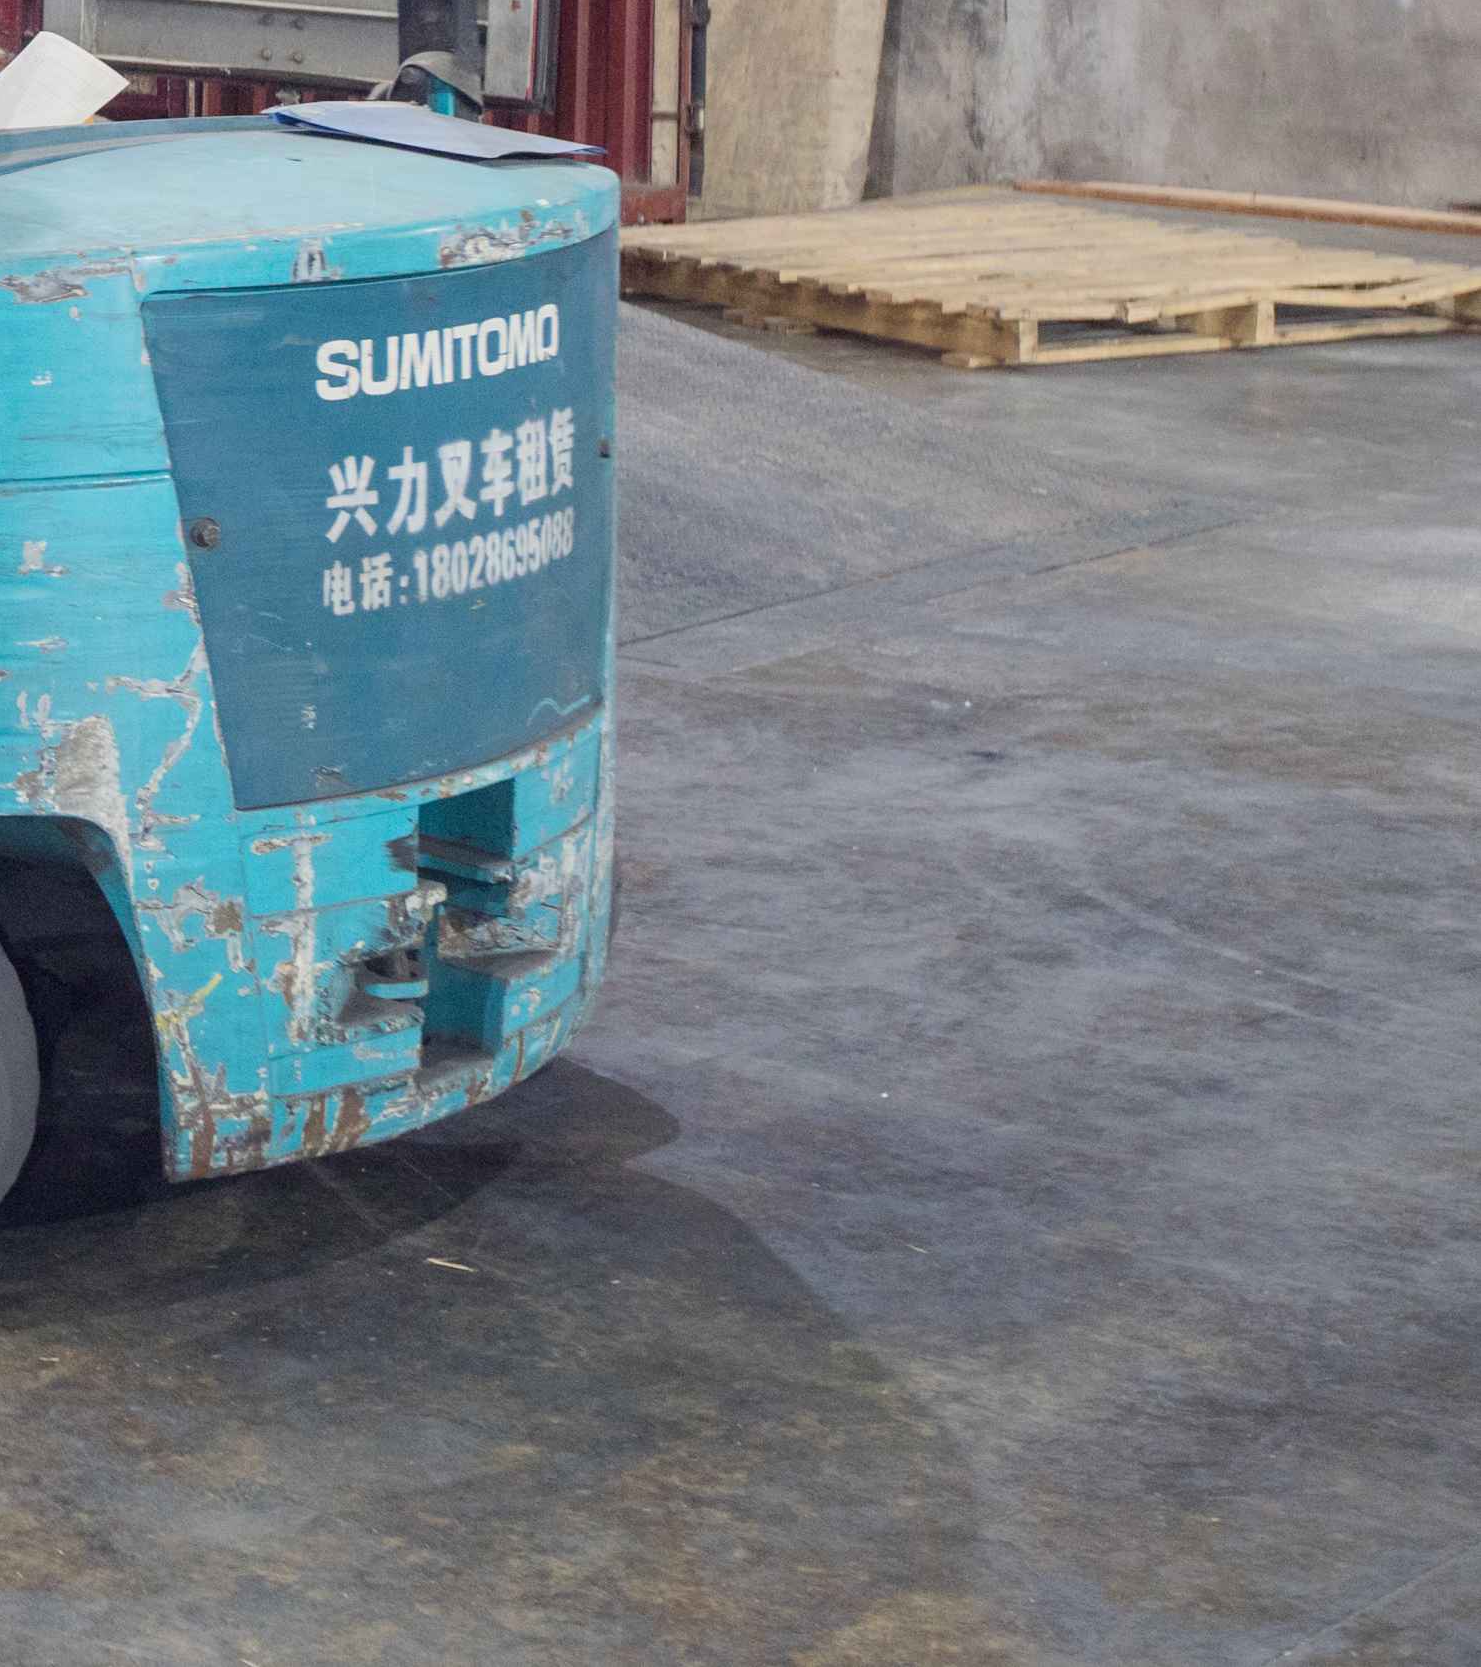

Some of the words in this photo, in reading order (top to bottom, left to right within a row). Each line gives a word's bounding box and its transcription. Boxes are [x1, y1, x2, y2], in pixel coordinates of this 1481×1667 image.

[315, 302, 560, 402] SUMITOMO
[324, 406, 575, 544] 兴力叉车租赁
